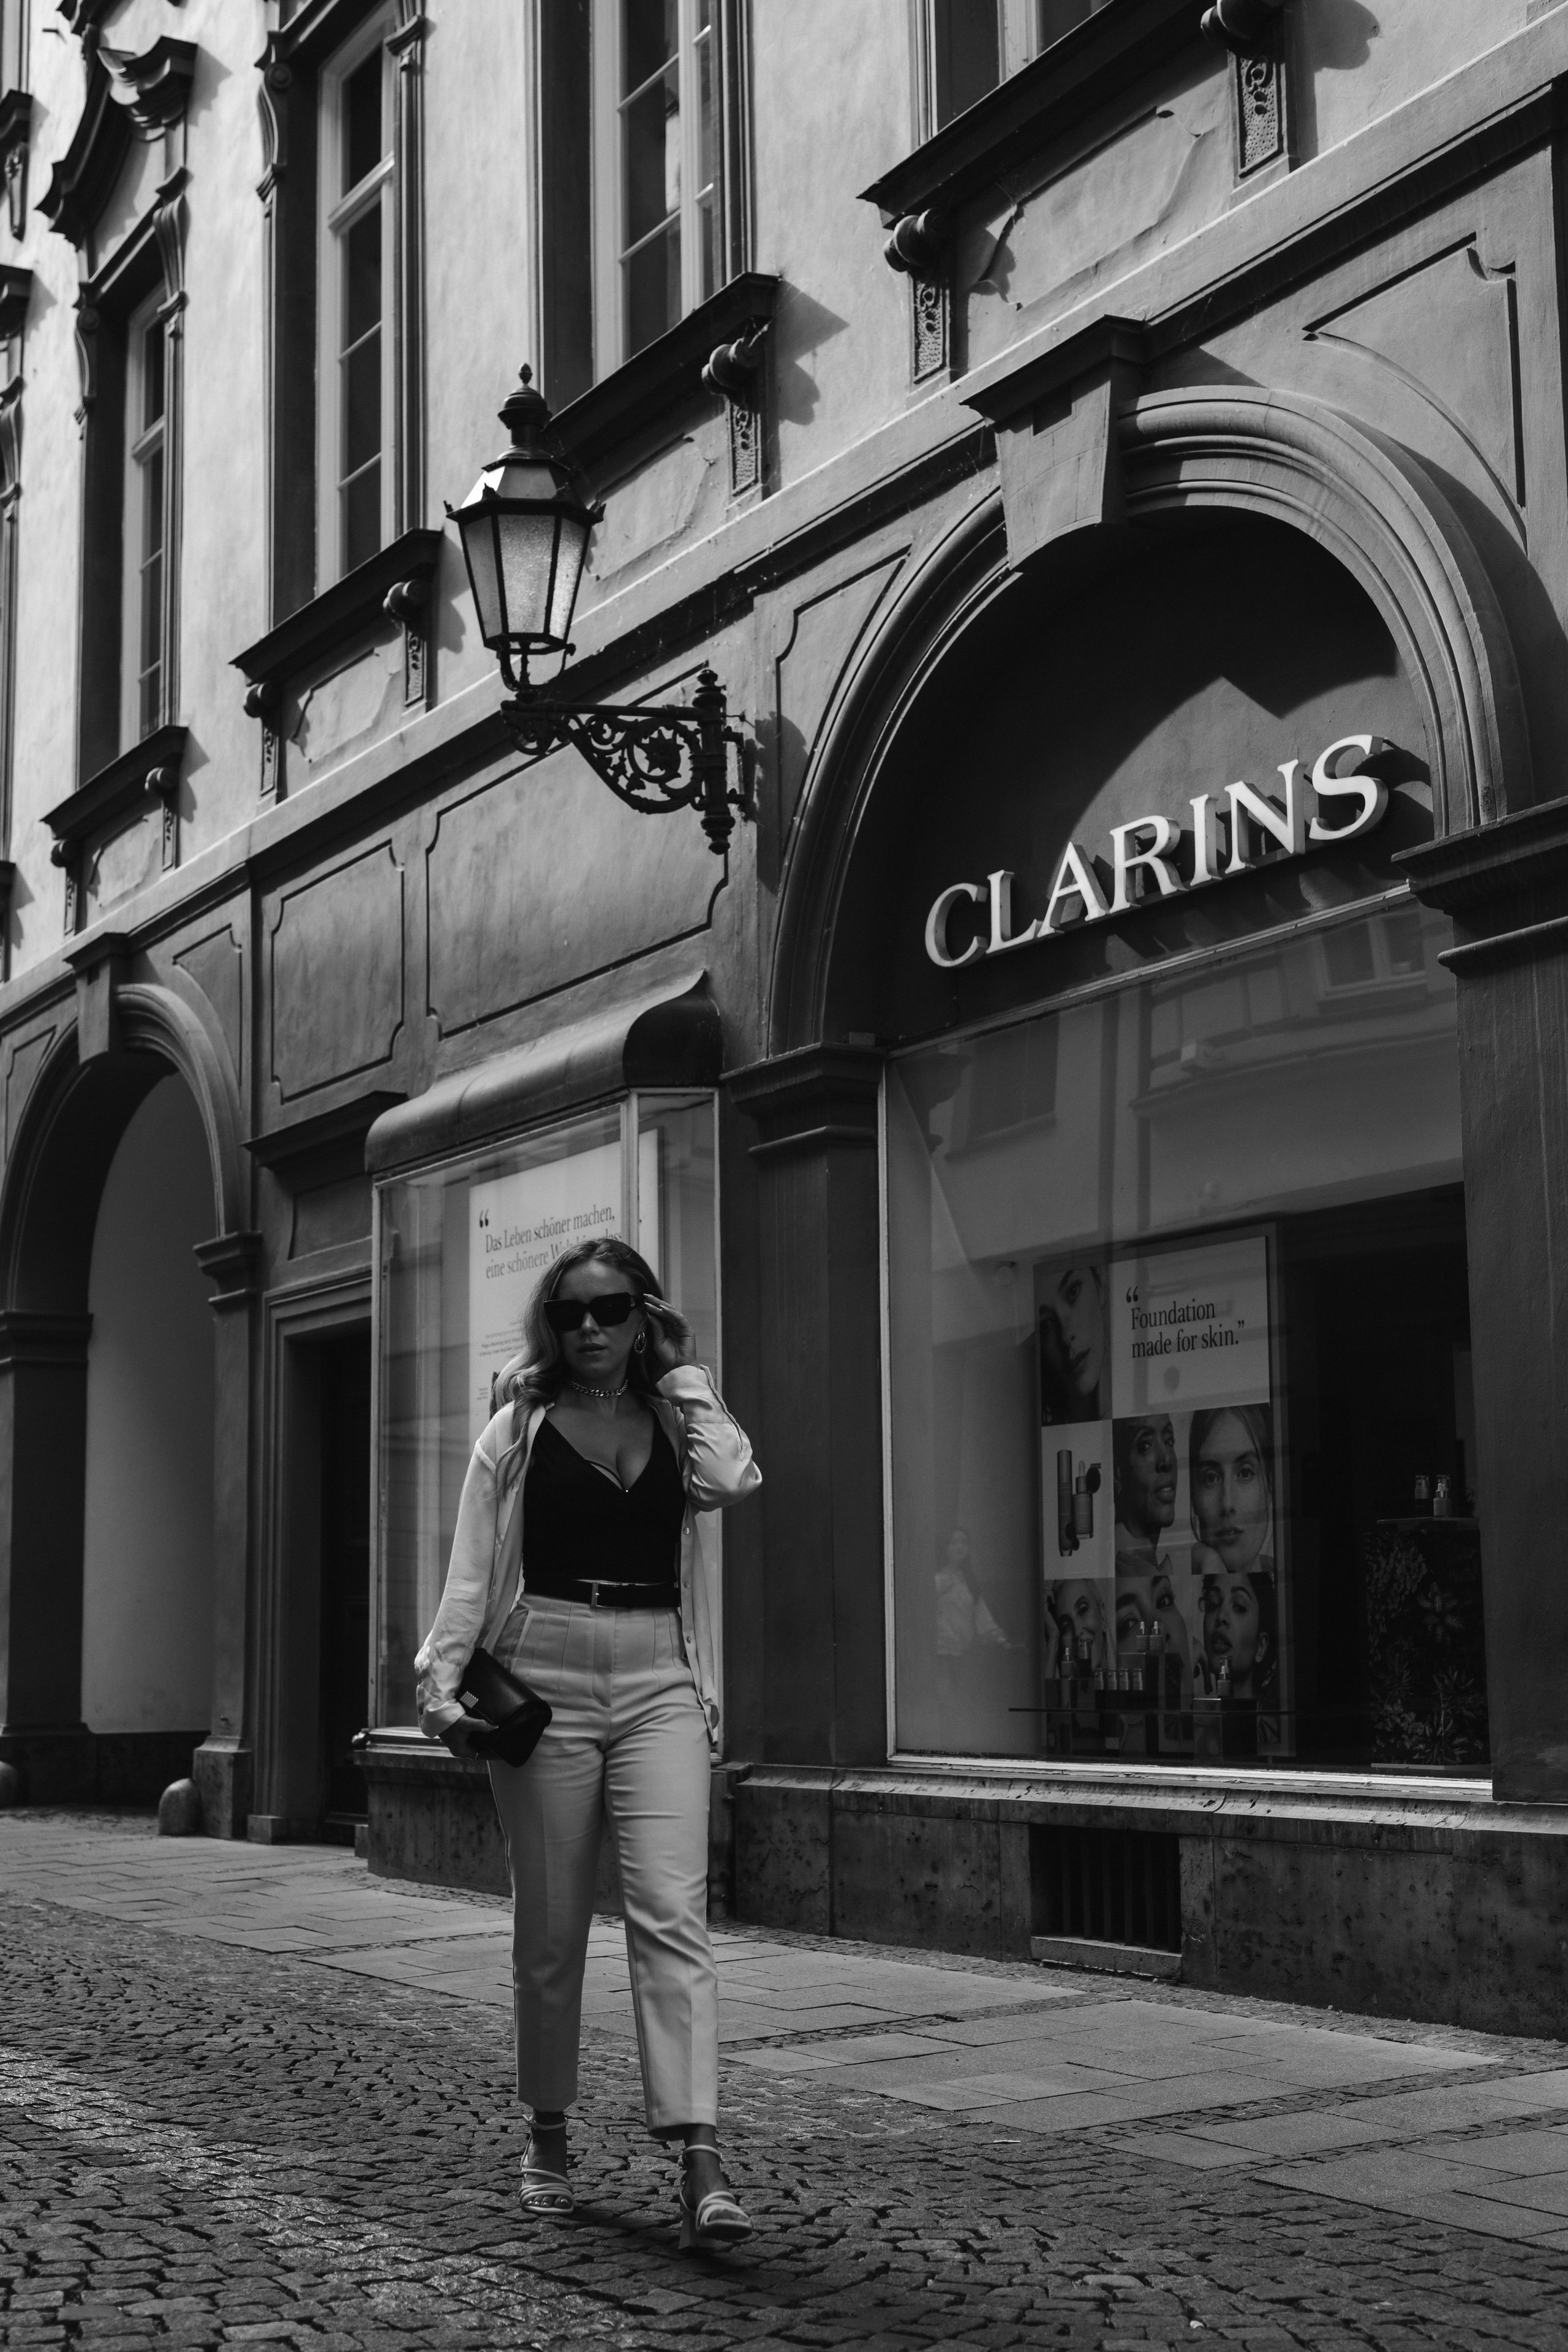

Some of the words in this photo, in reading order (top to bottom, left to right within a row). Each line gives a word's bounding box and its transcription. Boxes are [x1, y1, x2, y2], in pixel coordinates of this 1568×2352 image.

[925, 734, 1389, 967] CLARINS
[486, 1234, 502, 1253] Das
[505, 1226, 532, 1248] Leben
[534, 1217, 571, 1239] schöner
[486, 1259, 505, 1279] eine
[507, 1251, 549, 1273] schönere
[1131, 1298, 1216, 1330] Foundation
[1131, 1332, 1172, 1359] made
[1177, 1329, 1198, 1352] for
